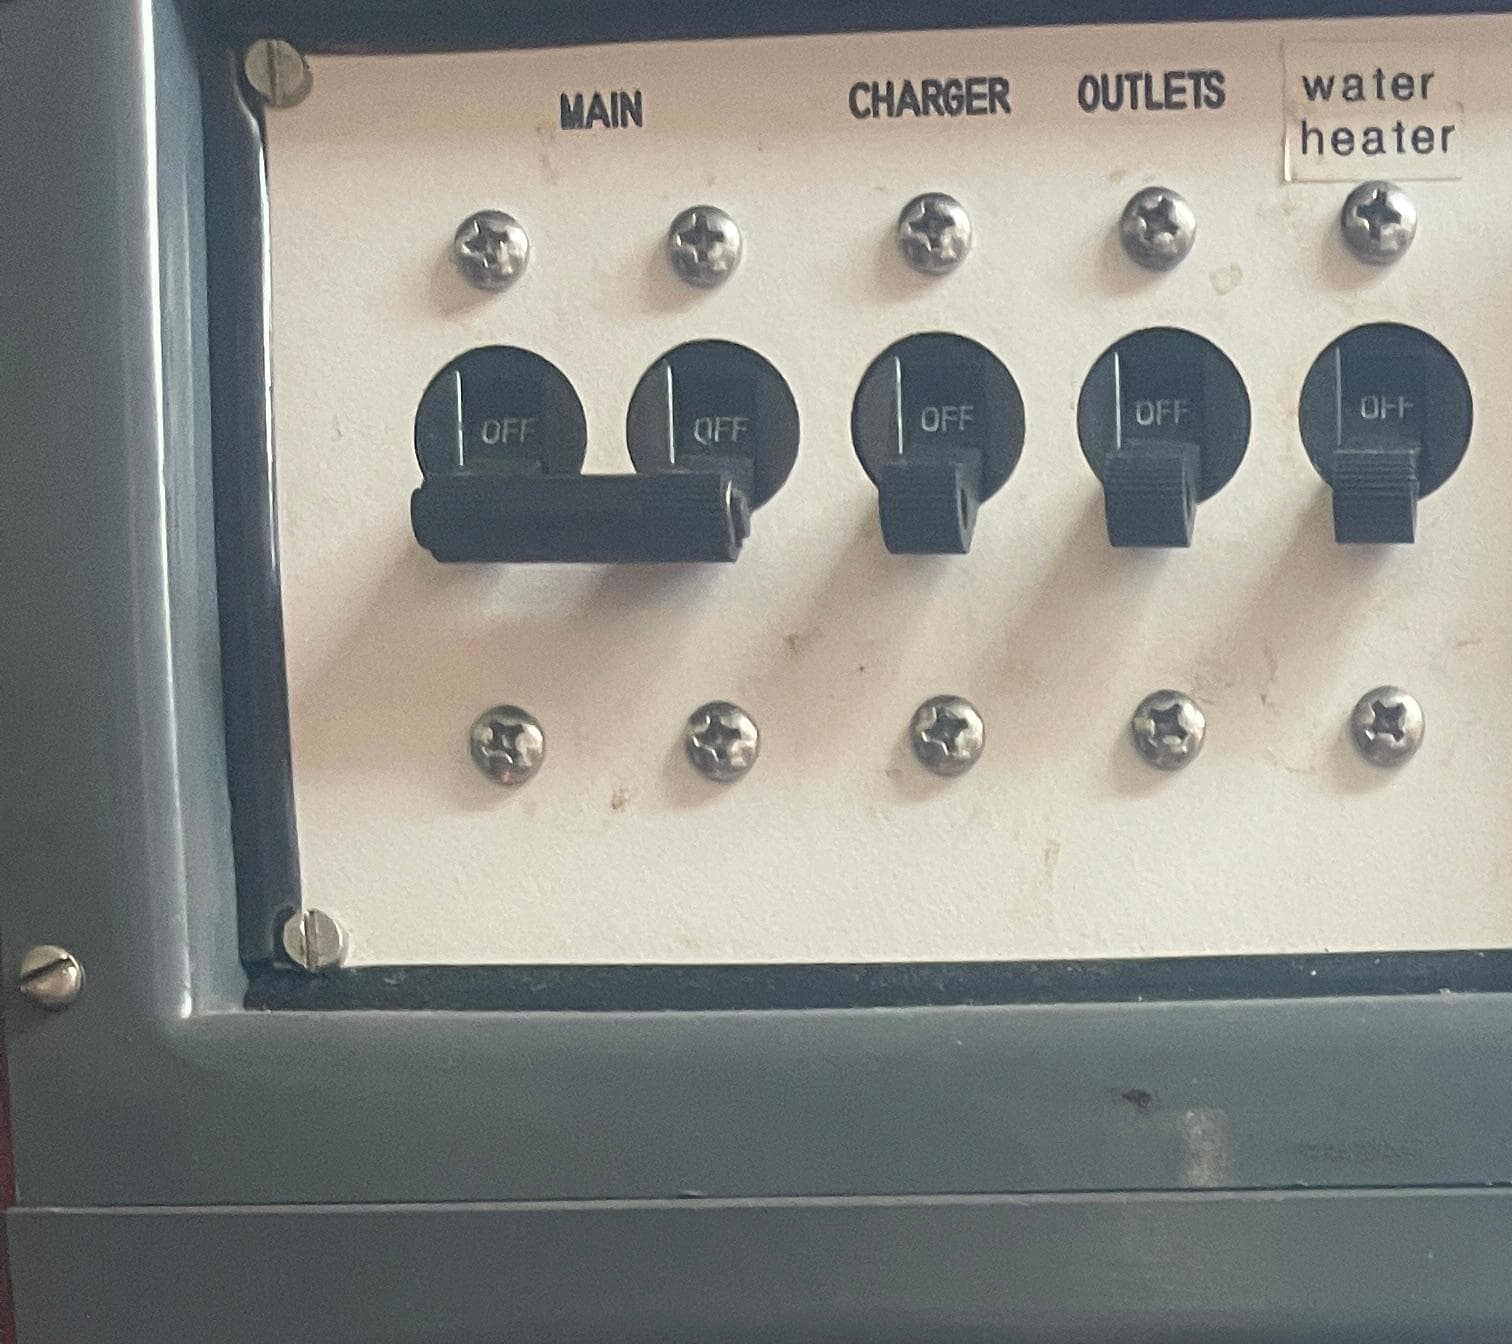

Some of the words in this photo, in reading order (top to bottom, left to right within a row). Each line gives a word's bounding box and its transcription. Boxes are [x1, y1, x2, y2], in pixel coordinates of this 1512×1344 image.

[848, 78, 1013, 119] CHARGER
[1078, 69, 1225, 112] OUTLETS
[1301, 67, 1435, 101] water
[560, 89, 644, 129] MAIN
[1300, 119, 1456, 155] heater
[921, 405, 975, 433] OFF
[1135, 399, 1190, 427] OFF
[1359, 395, 1414, 421] OFF
[482, 417, 536, 446] OFF
[693, 416, 748, 446] OFF
